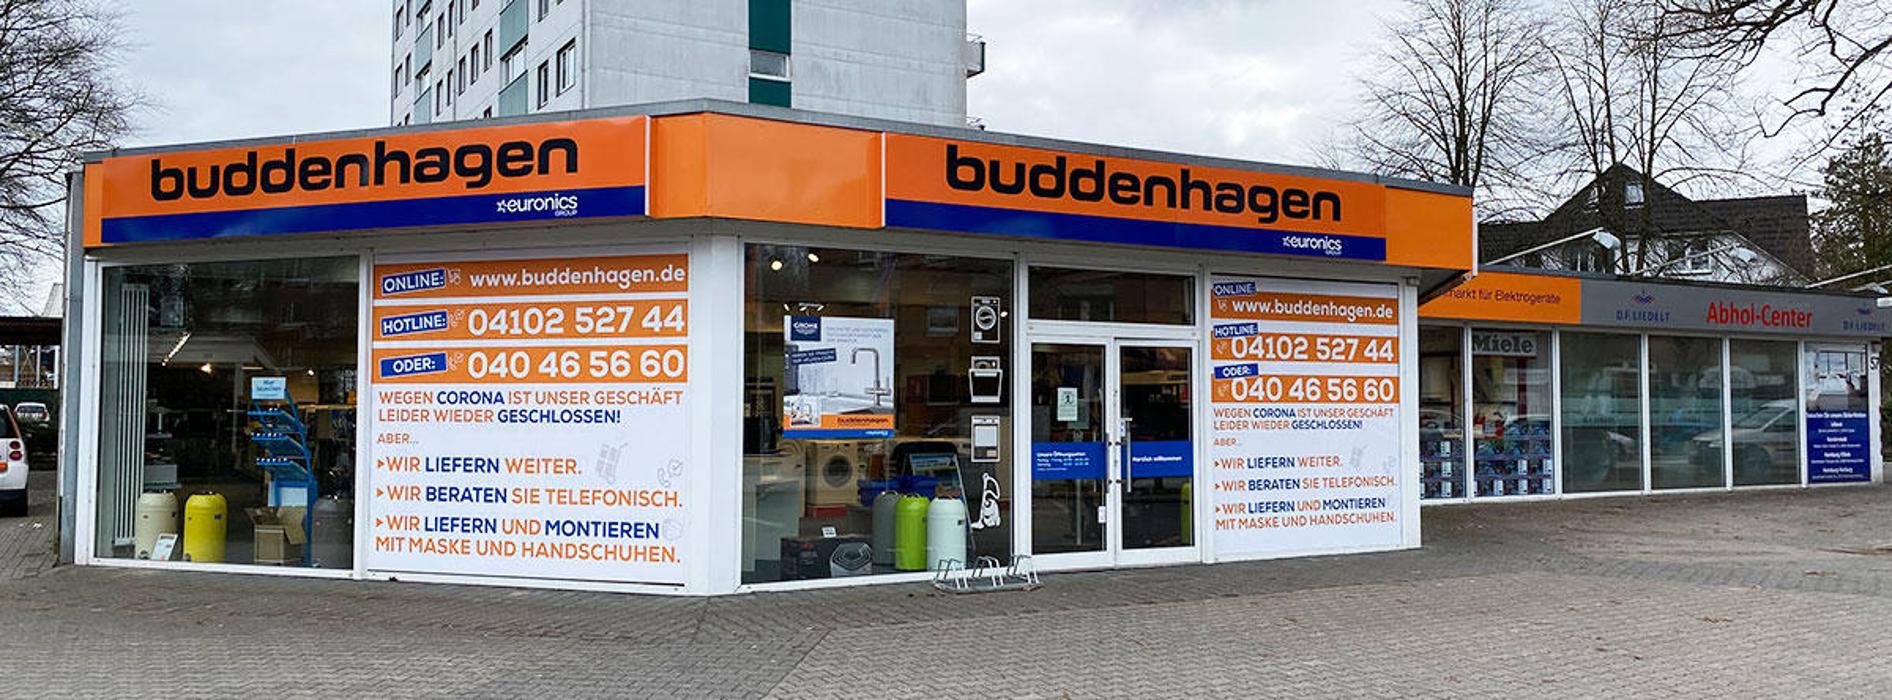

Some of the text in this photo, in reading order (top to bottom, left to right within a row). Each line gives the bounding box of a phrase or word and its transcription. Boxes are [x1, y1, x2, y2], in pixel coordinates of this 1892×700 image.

[151, 137, 578, 201] buddenhagen
[946, 144, 1342, 224] buddenhagen
[507, 193, 578, 213] euronics
[1290, 236, 1343, 251] euronics
[383, 265, 686, 293] ONLINE: www.buddenhagen.de
[1479, 288, 1493, 300] für
[382, 305, 685, 335] HOTLINE: 04102 527 44
[1232, 299, 1393, 322] www.buddenhagen.de
[1633, 310, 1670, 323] LIEDELT
[1706, 302, 1813, 329] Abhol-Center
[1231, 336, 1394, 361] 04102 527 44
[1474, 335, 1534, 353] Miele
[392, 350, 684, 379] ODER: 040 46 56 60
[379, 387, 684, 405] WEGEN CORONA IST UNSER GESCHÄFT
[1231, 377, 1394, 401] 040 46 56 60
[378, 409, 622, 424] LEIDER WIEDER GESCHLOSSEN!
[1214, 408, 1251, 418] WEGEN
[1253, 408, 1296, 418] CORONA
[1297, 408, 1312, 418] IST
[1315, 408, 1345, 418] UNSER
[1214, 420, 1363, 430] LEIDER WIEDER GESCHLOSSEN!
[377, 433, 419, 445] ABER...
[386, 456, 582, 475] WIR LIEFERN WEITER.
[1221, 456, 1343, 469] WIR LIEFERN WEITER.
[1222, 476, 1397, 491] WIR BERATEN SIE TELEFONISCH.
[387, 486, 683, 508] WIR BERATEN SIE TELEFONISCH.
[1222, 498, 1386, 514] WIR LIEFERN UND MONTIEREN
[386, 515, 660, 539] WIR LIEFERN UND MONTIEREN
[1215, 511, 1397, 530] MIT MASKE UND HANDSCHUHEN.
[376, 536, 681, 564] MIT MASKE UND HANDSCHUHEN.
